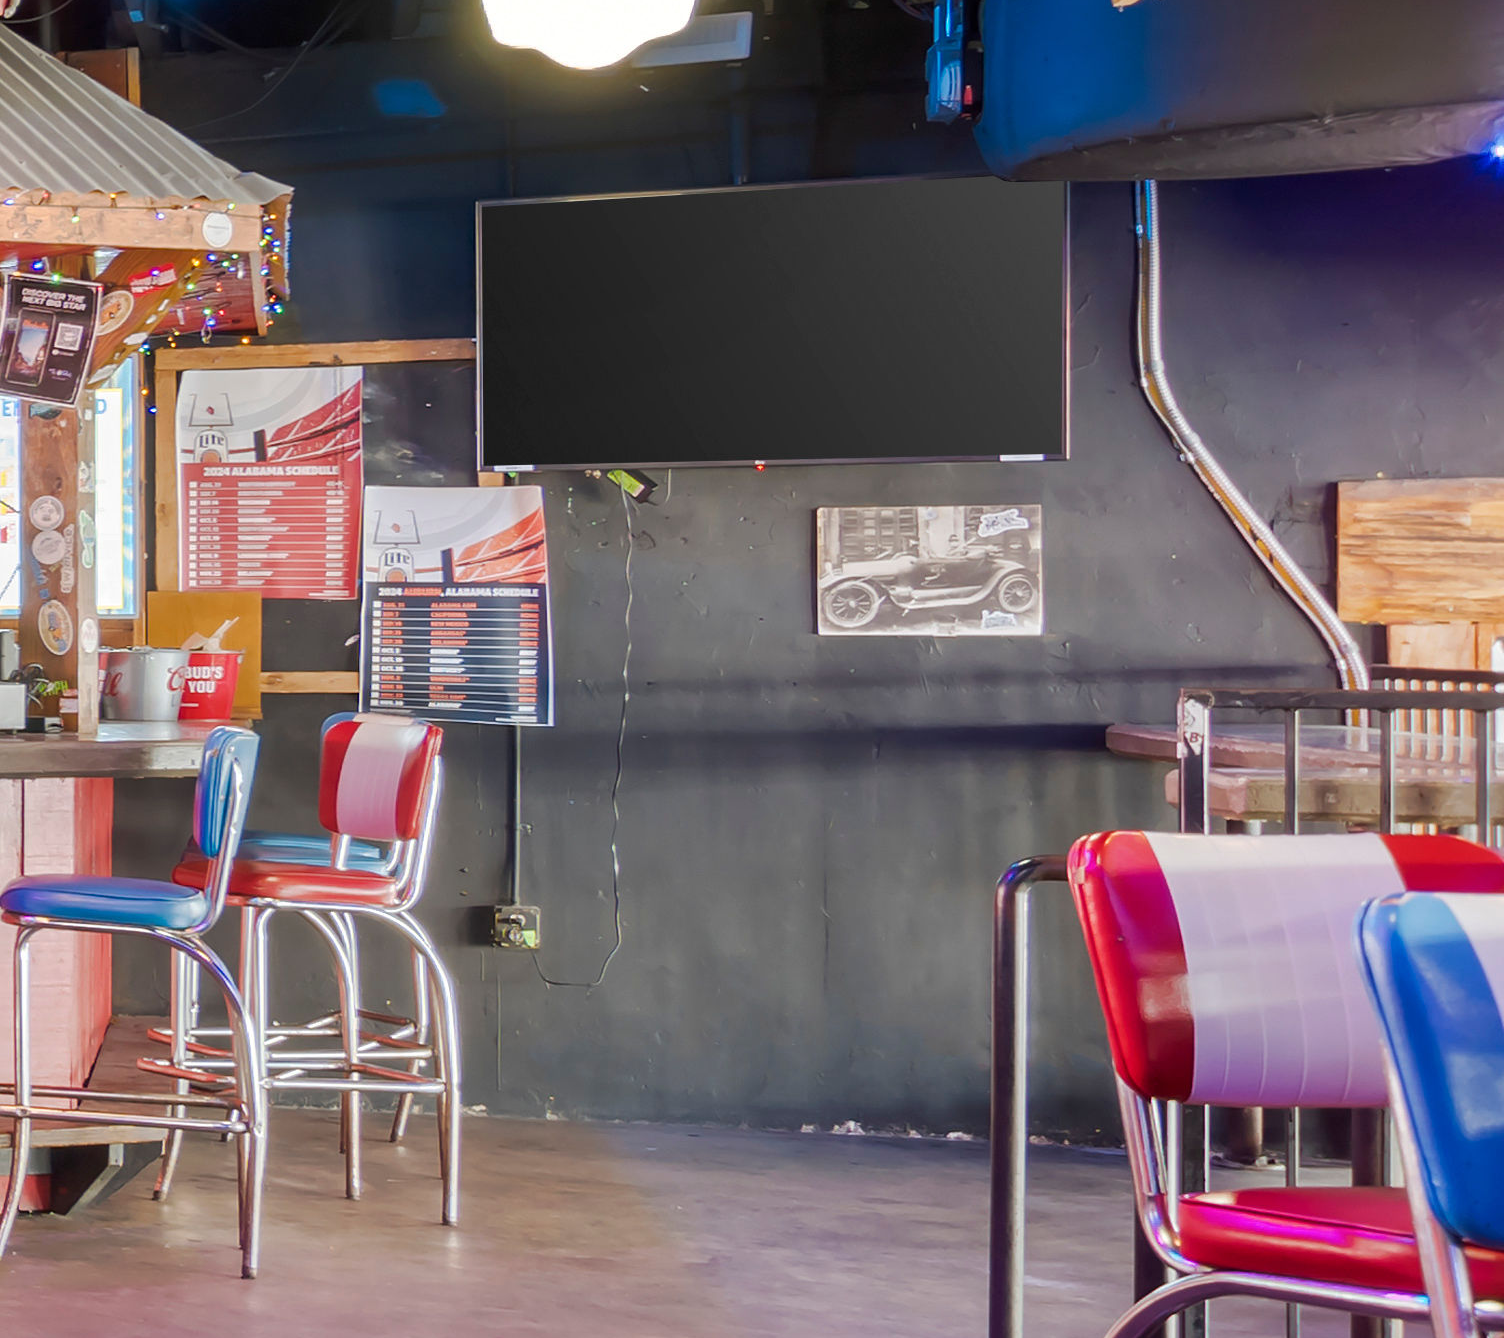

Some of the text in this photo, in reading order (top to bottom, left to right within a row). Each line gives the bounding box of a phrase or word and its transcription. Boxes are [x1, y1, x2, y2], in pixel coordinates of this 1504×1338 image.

[22, 288, 85, 302] DISCOVER THE
[22, 296, 44, 305] NEXT
[63, 301, 86, 310] STAR
[199, 434, 224, 448] Lite
[203, 465, 340, 477] 2024 ALABAMA SCHEDULE
[384, 552, 410, 566] Lite
[445, 588, 492, 597] ALABAMA
[492, 588, 539, 598] SCHEDULE
[188, 681, 216, 693] YOU
